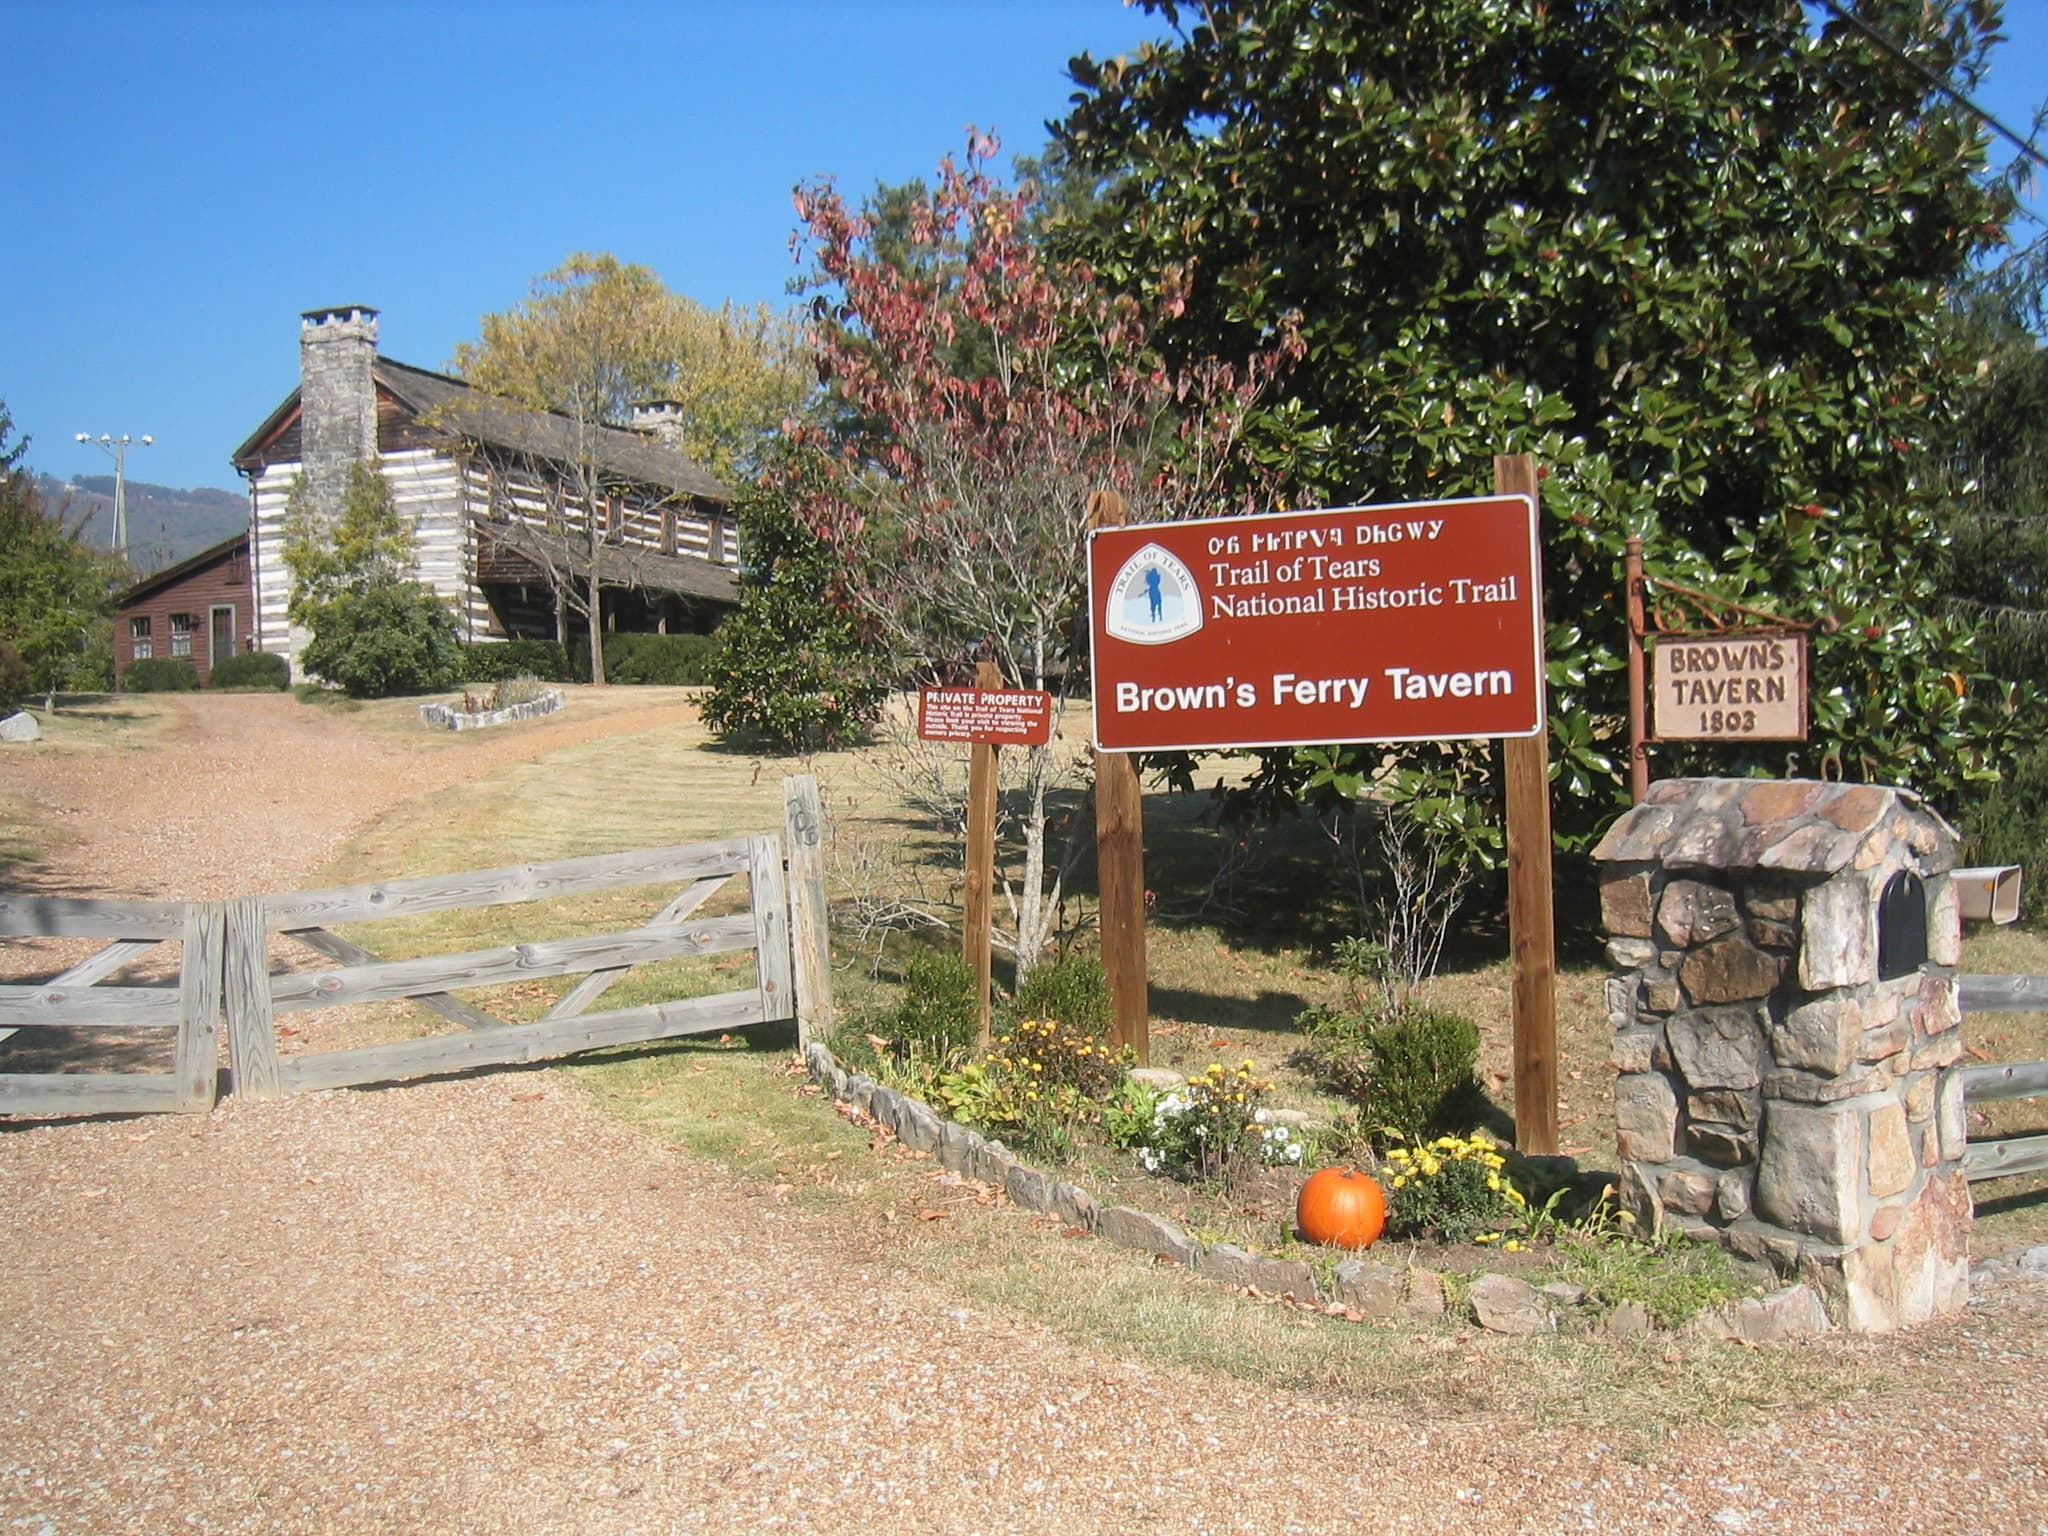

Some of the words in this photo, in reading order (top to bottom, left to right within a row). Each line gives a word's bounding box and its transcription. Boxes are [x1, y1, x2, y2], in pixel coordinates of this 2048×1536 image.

[1115, 561, 1142, 595] TRAIL
[1143, 551, 1158, 560] OF
[1162, 556, 1191, 591] TEARS
[1209, 560, 1269, 588] Trail
[1276, 556, 1302, 583] of
[1308, 555, 1381, 582] Tears
[1211, 589, 1324, 619] National
[1332, 583, 1443, 612] Historic
[1449, 576, 1518, 604] Trail
[1670, 640, 1784, 673] BROWN'S
[926, 691, 976, 704] PRIVATE
[981, 692, 1043, 706] PROPERTY
[1115, 676, 1256, 712] Brown's
[1273, 673, 1369, 708] Ferry
[1385, 667, 1512, 700] Tavern
[1672, 675, 1785, 705] TAVERN
[1700, 710, 1757, 733] 1803
